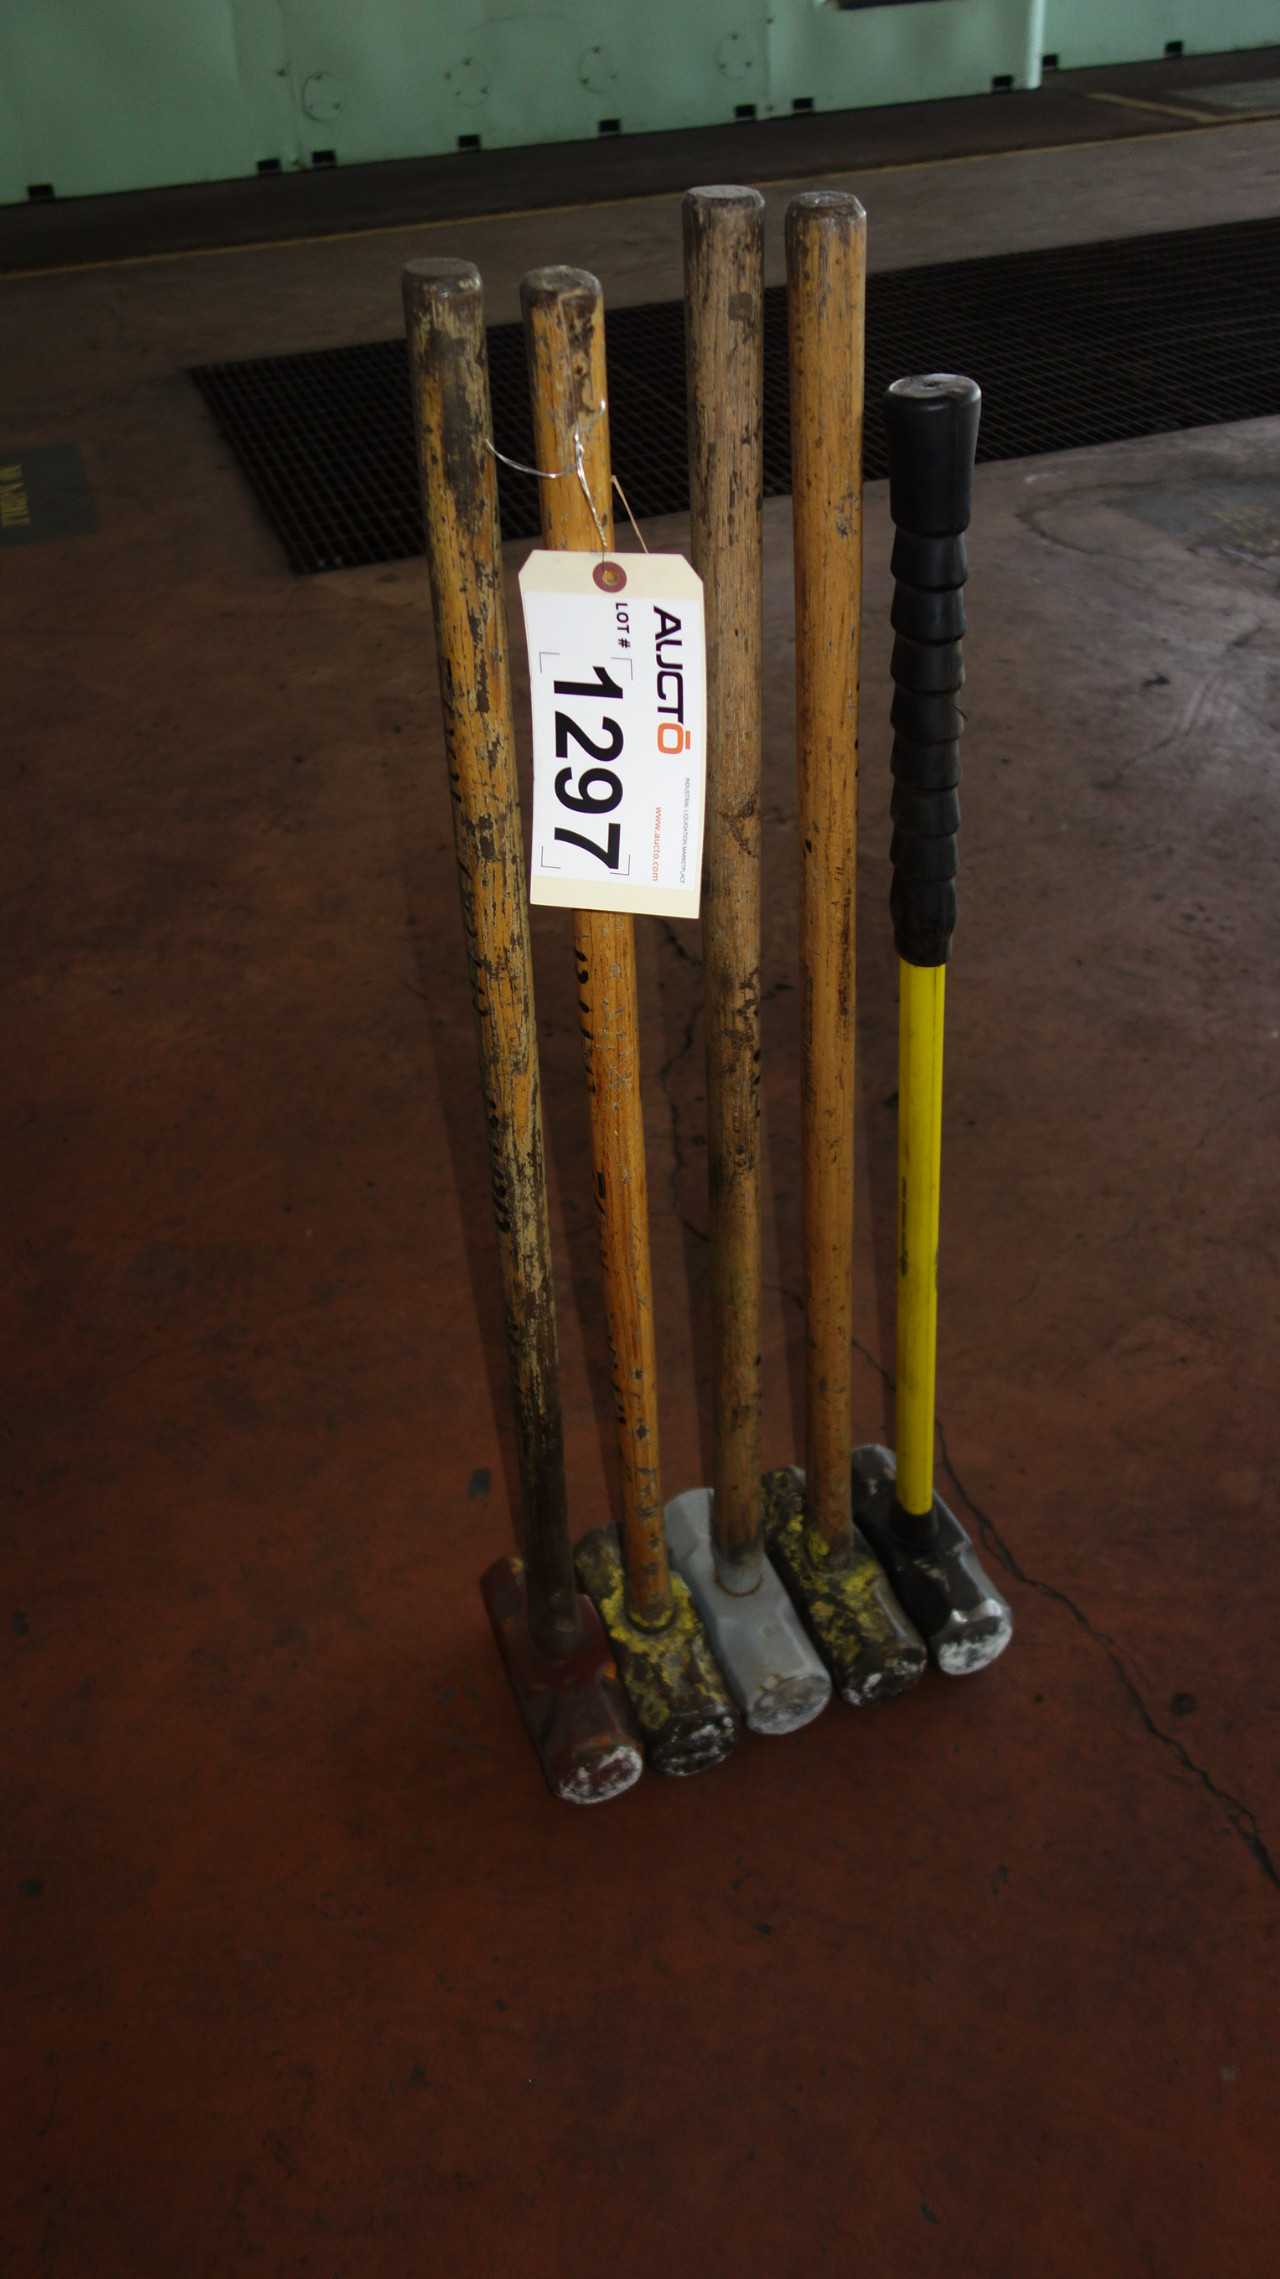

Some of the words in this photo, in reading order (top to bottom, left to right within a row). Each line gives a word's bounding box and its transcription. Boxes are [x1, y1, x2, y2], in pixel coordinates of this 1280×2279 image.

[616, 603, 630, 633] LOT
[618, 638, 630, 649] #
[554, 666, 624, 870] 1297
[652, 806, 665, 882] www.aucto.com
